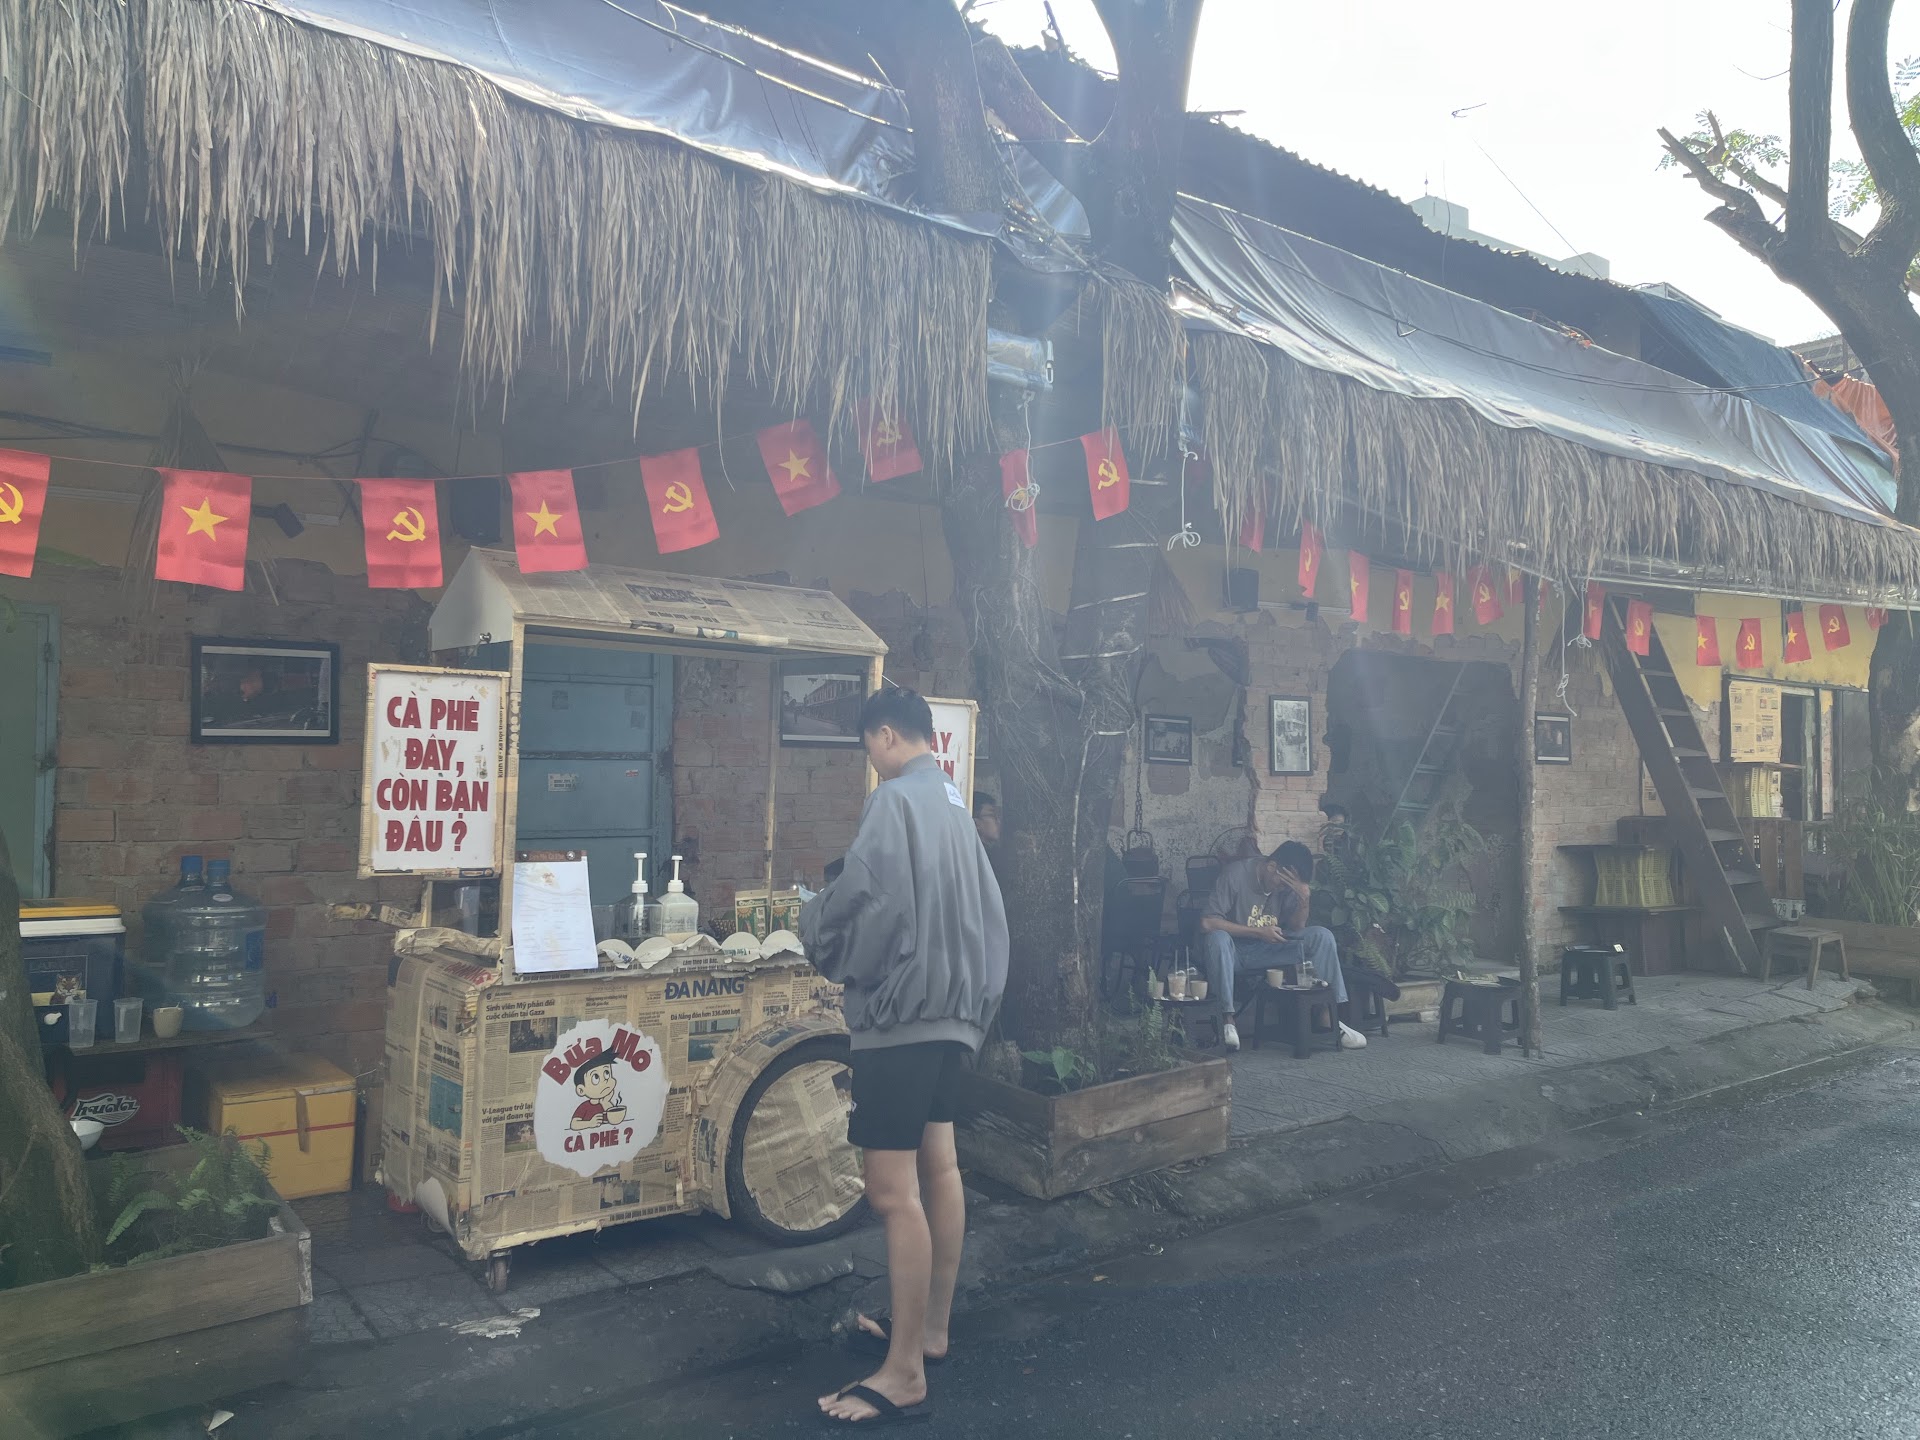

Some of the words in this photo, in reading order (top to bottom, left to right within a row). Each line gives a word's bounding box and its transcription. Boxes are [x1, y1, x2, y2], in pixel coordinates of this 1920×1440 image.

[387, 691, 422, 729] CÀ
[430, 695, 480, 732] PHÊ
[404, 733, 464, 778] ĐÂY,
[376, 772, 428, 811] CÒN
[435, 778, 489, 819] BẠN
[385, 815, 444, 852] ĐÂU
[451, 820, 468, 851] ?
[485, 1013, 501, 1021] cuộc
[519, 1011, 528, 1019] tại
[516, 1001, 526, 1010] Mỹ
[527, 1000, 544, 1009] phản
[544, 998, 555, 1006] đối
[542, 1037, 603, 1086] Bữa
[611, 1028, 653, 1072] Mô
[481, 1105, 513, 1115] V-League
[513, 1102, 525, 1111] trở
[524, 1101, 534, 1112] lại
[481, 1115, 492, 1124] với
[564, 1132, 585, 1153] CÀ
[589, 1126, 619, 1150] PHÊ
[623, 1126, 634, 1144] ?
